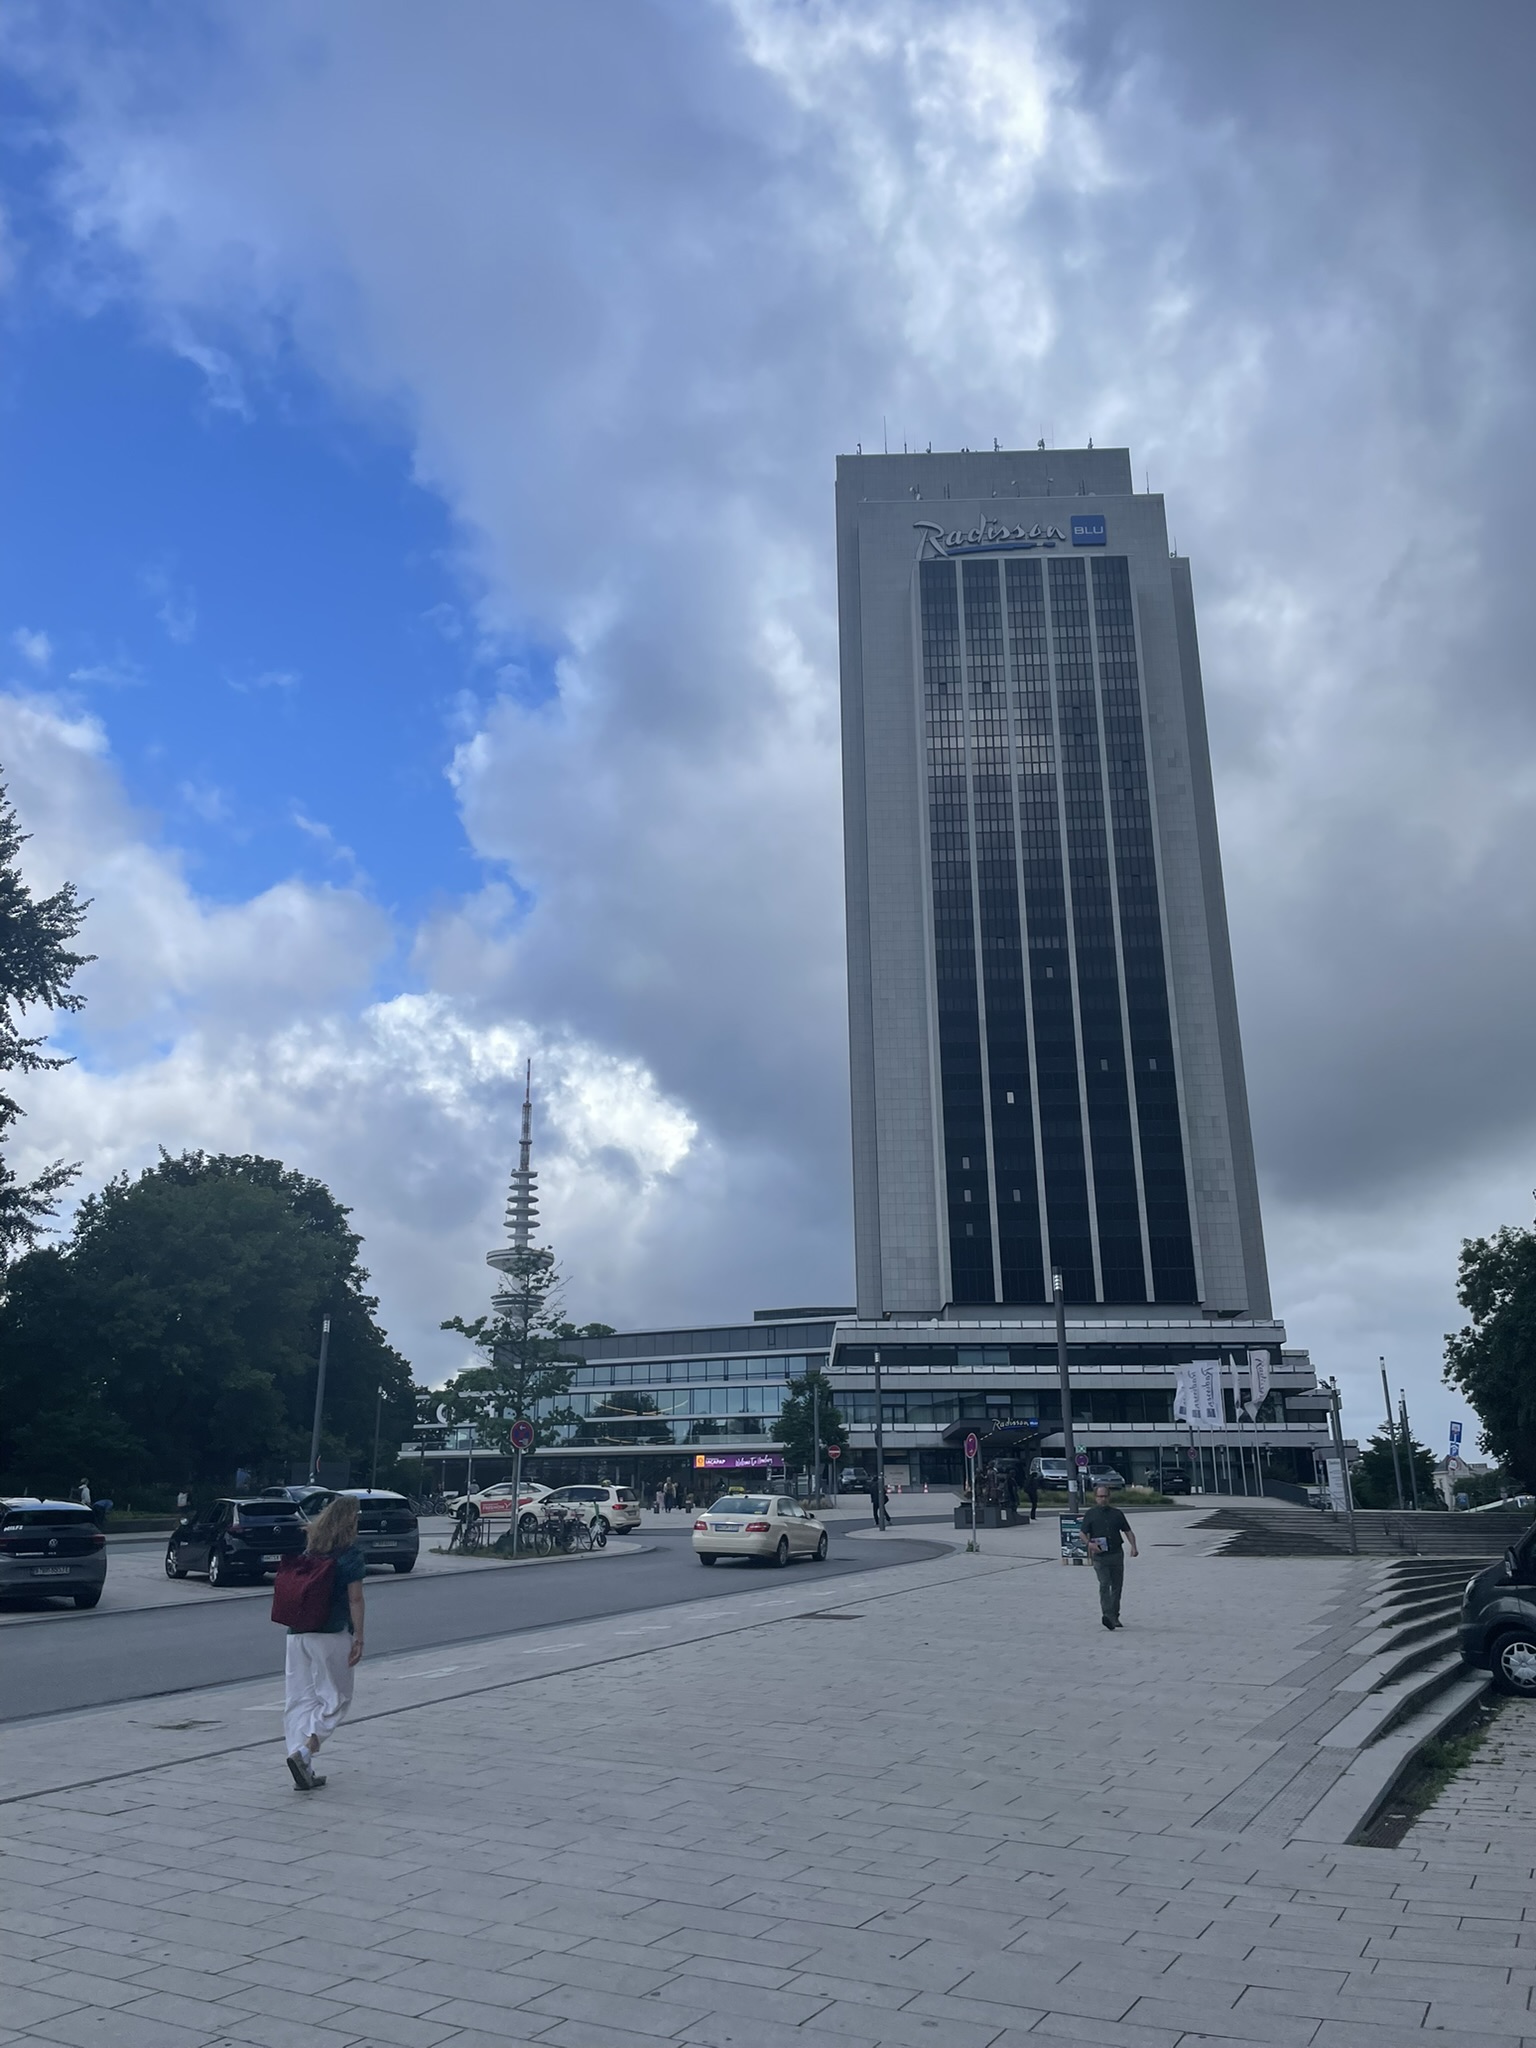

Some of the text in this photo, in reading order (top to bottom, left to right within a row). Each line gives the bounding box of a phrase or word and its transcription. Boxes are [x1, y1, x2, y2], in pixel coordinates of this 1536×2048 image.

[913, 512, 1104, 560] Radisson BLU
[991, 1417, 1030, 1431] Radisson
